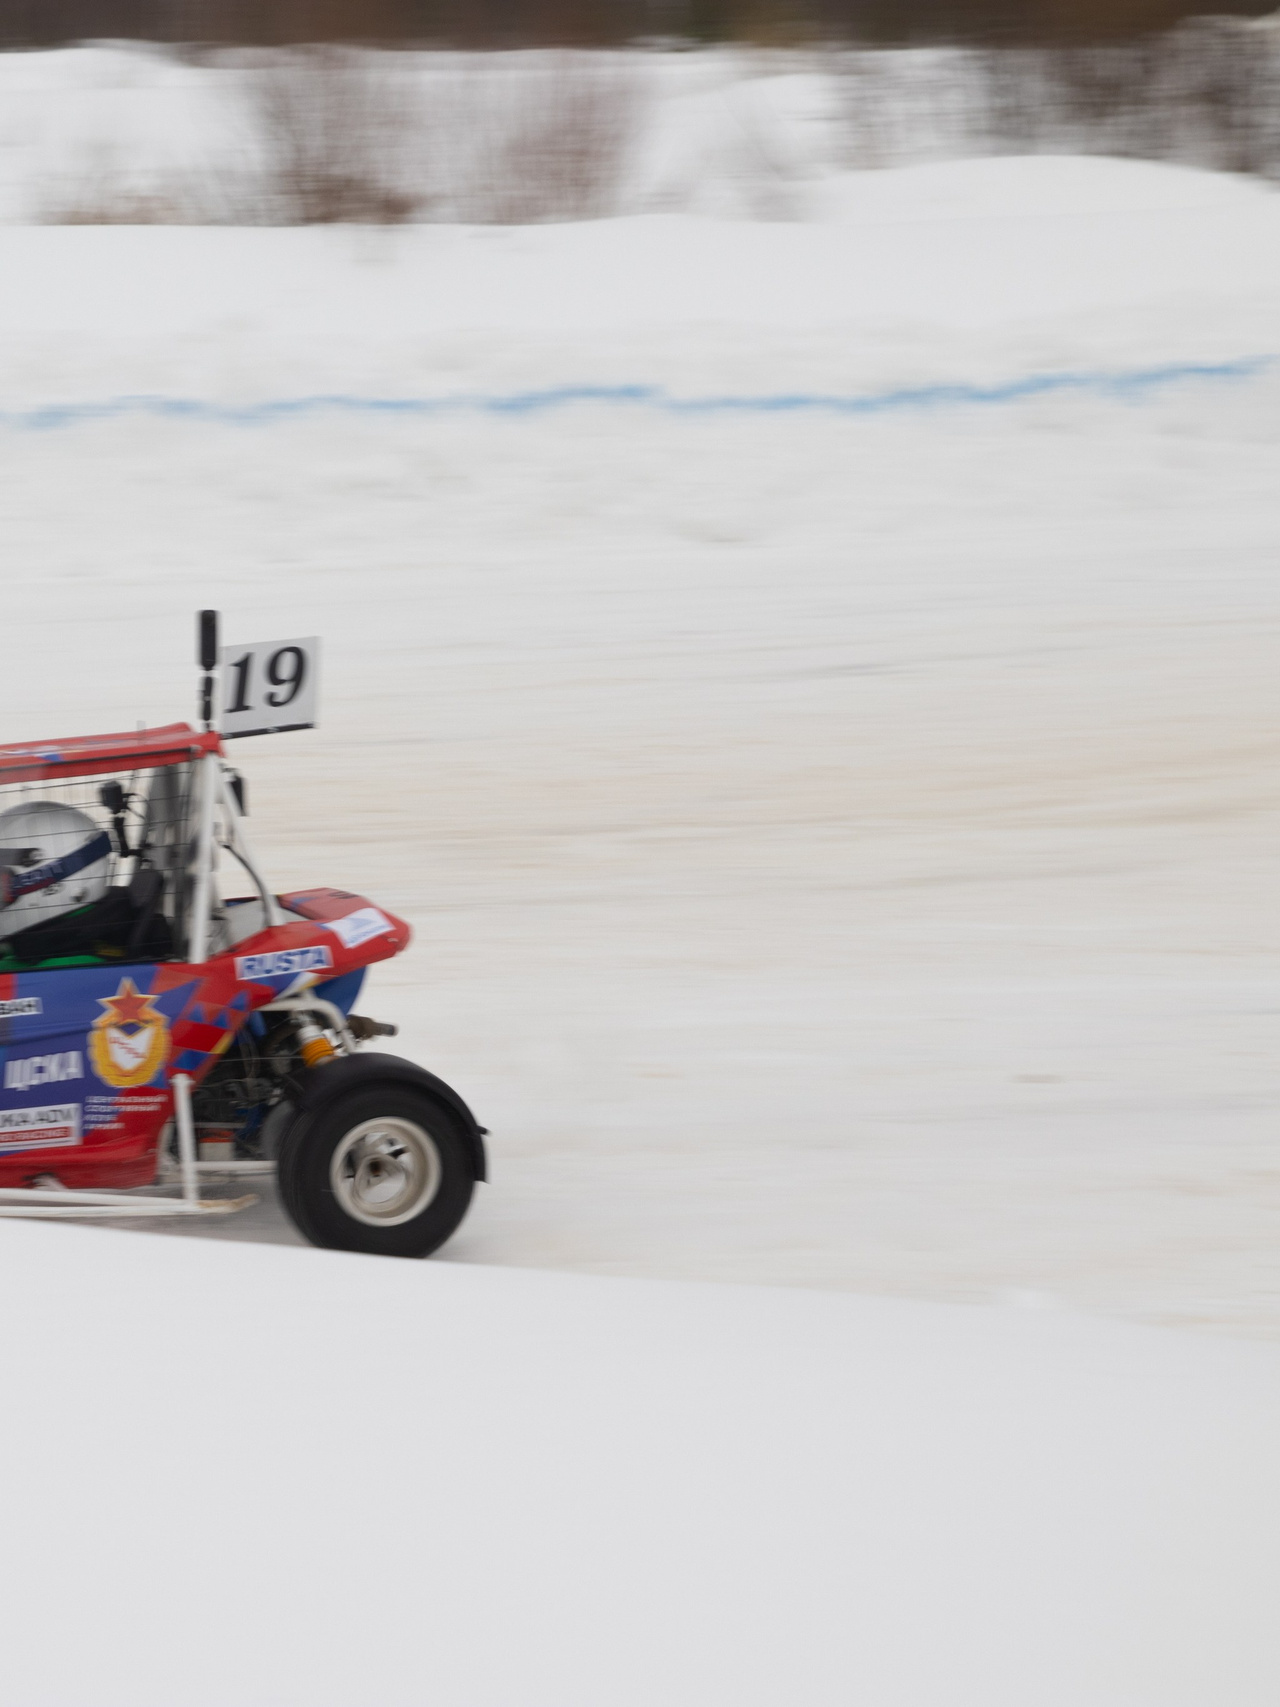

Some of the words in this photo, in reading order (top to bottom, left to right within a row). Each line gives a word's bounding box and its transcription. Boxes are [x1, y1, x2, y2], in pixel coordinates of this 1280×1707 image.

[224, 646, 308, 713] 19
[241, 945, 329, 979] RUSTA
[4, 1050, 85, 1091] ЦСКА
